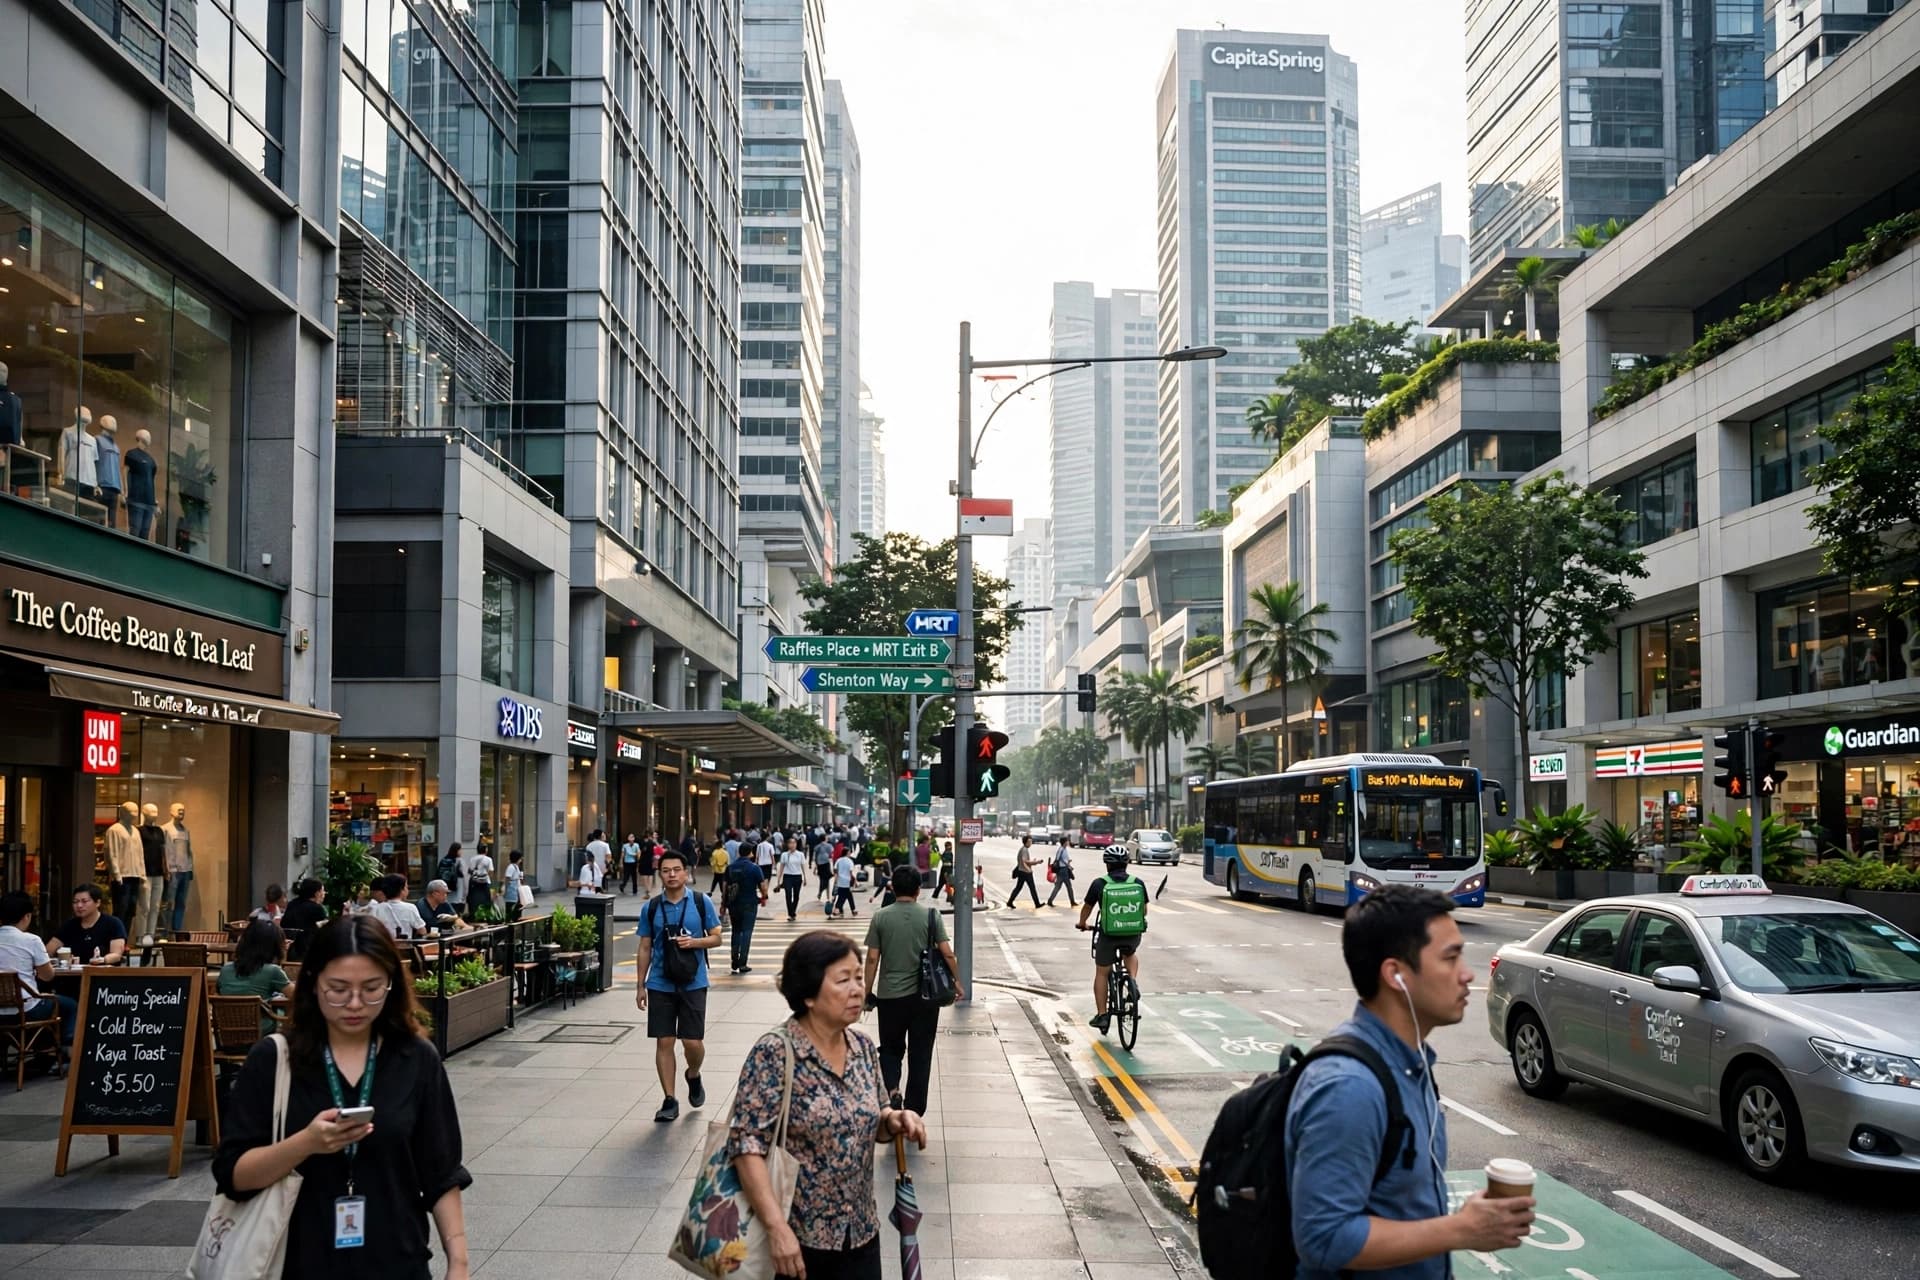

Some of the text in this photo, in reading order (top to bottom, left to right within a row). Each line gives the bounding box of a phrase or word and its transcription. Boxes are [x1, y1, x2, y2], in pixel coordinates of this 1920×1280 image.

[1211, 47, 1324, 72] CapitaSpring
[11, 588, 256, 671] The Coffee Bean & Tea Leaf
[780, 642, 939, 658] Raffles Place MRT Exit B
[818, 673, 909, 690] Shenton Way
[132, 690, 151, 708] The
[153, 694, 183, 713] Coffee
[185, 698, 209, 717] Bean
[88, 718, 115, 741] UNI
[515, 702, 543, 740] DBS
[1845, 723, 1920, 748] Guardian
[87, 745, 118, 768] QLO
[1368, 774, 1384, 786] Bus
[1385, 775, 1400, 786] 100
[1407, 775, 1418, 786] To
[1449, 776, 1464, 789] Bay
[96, 988, 181, 1012] Morning Special
[99, 1016, 164, 1035] Cold Brew
[95, 1043, 167, 1067] Kaya Toast
[101, 1071, 155, 1096] $5.50
